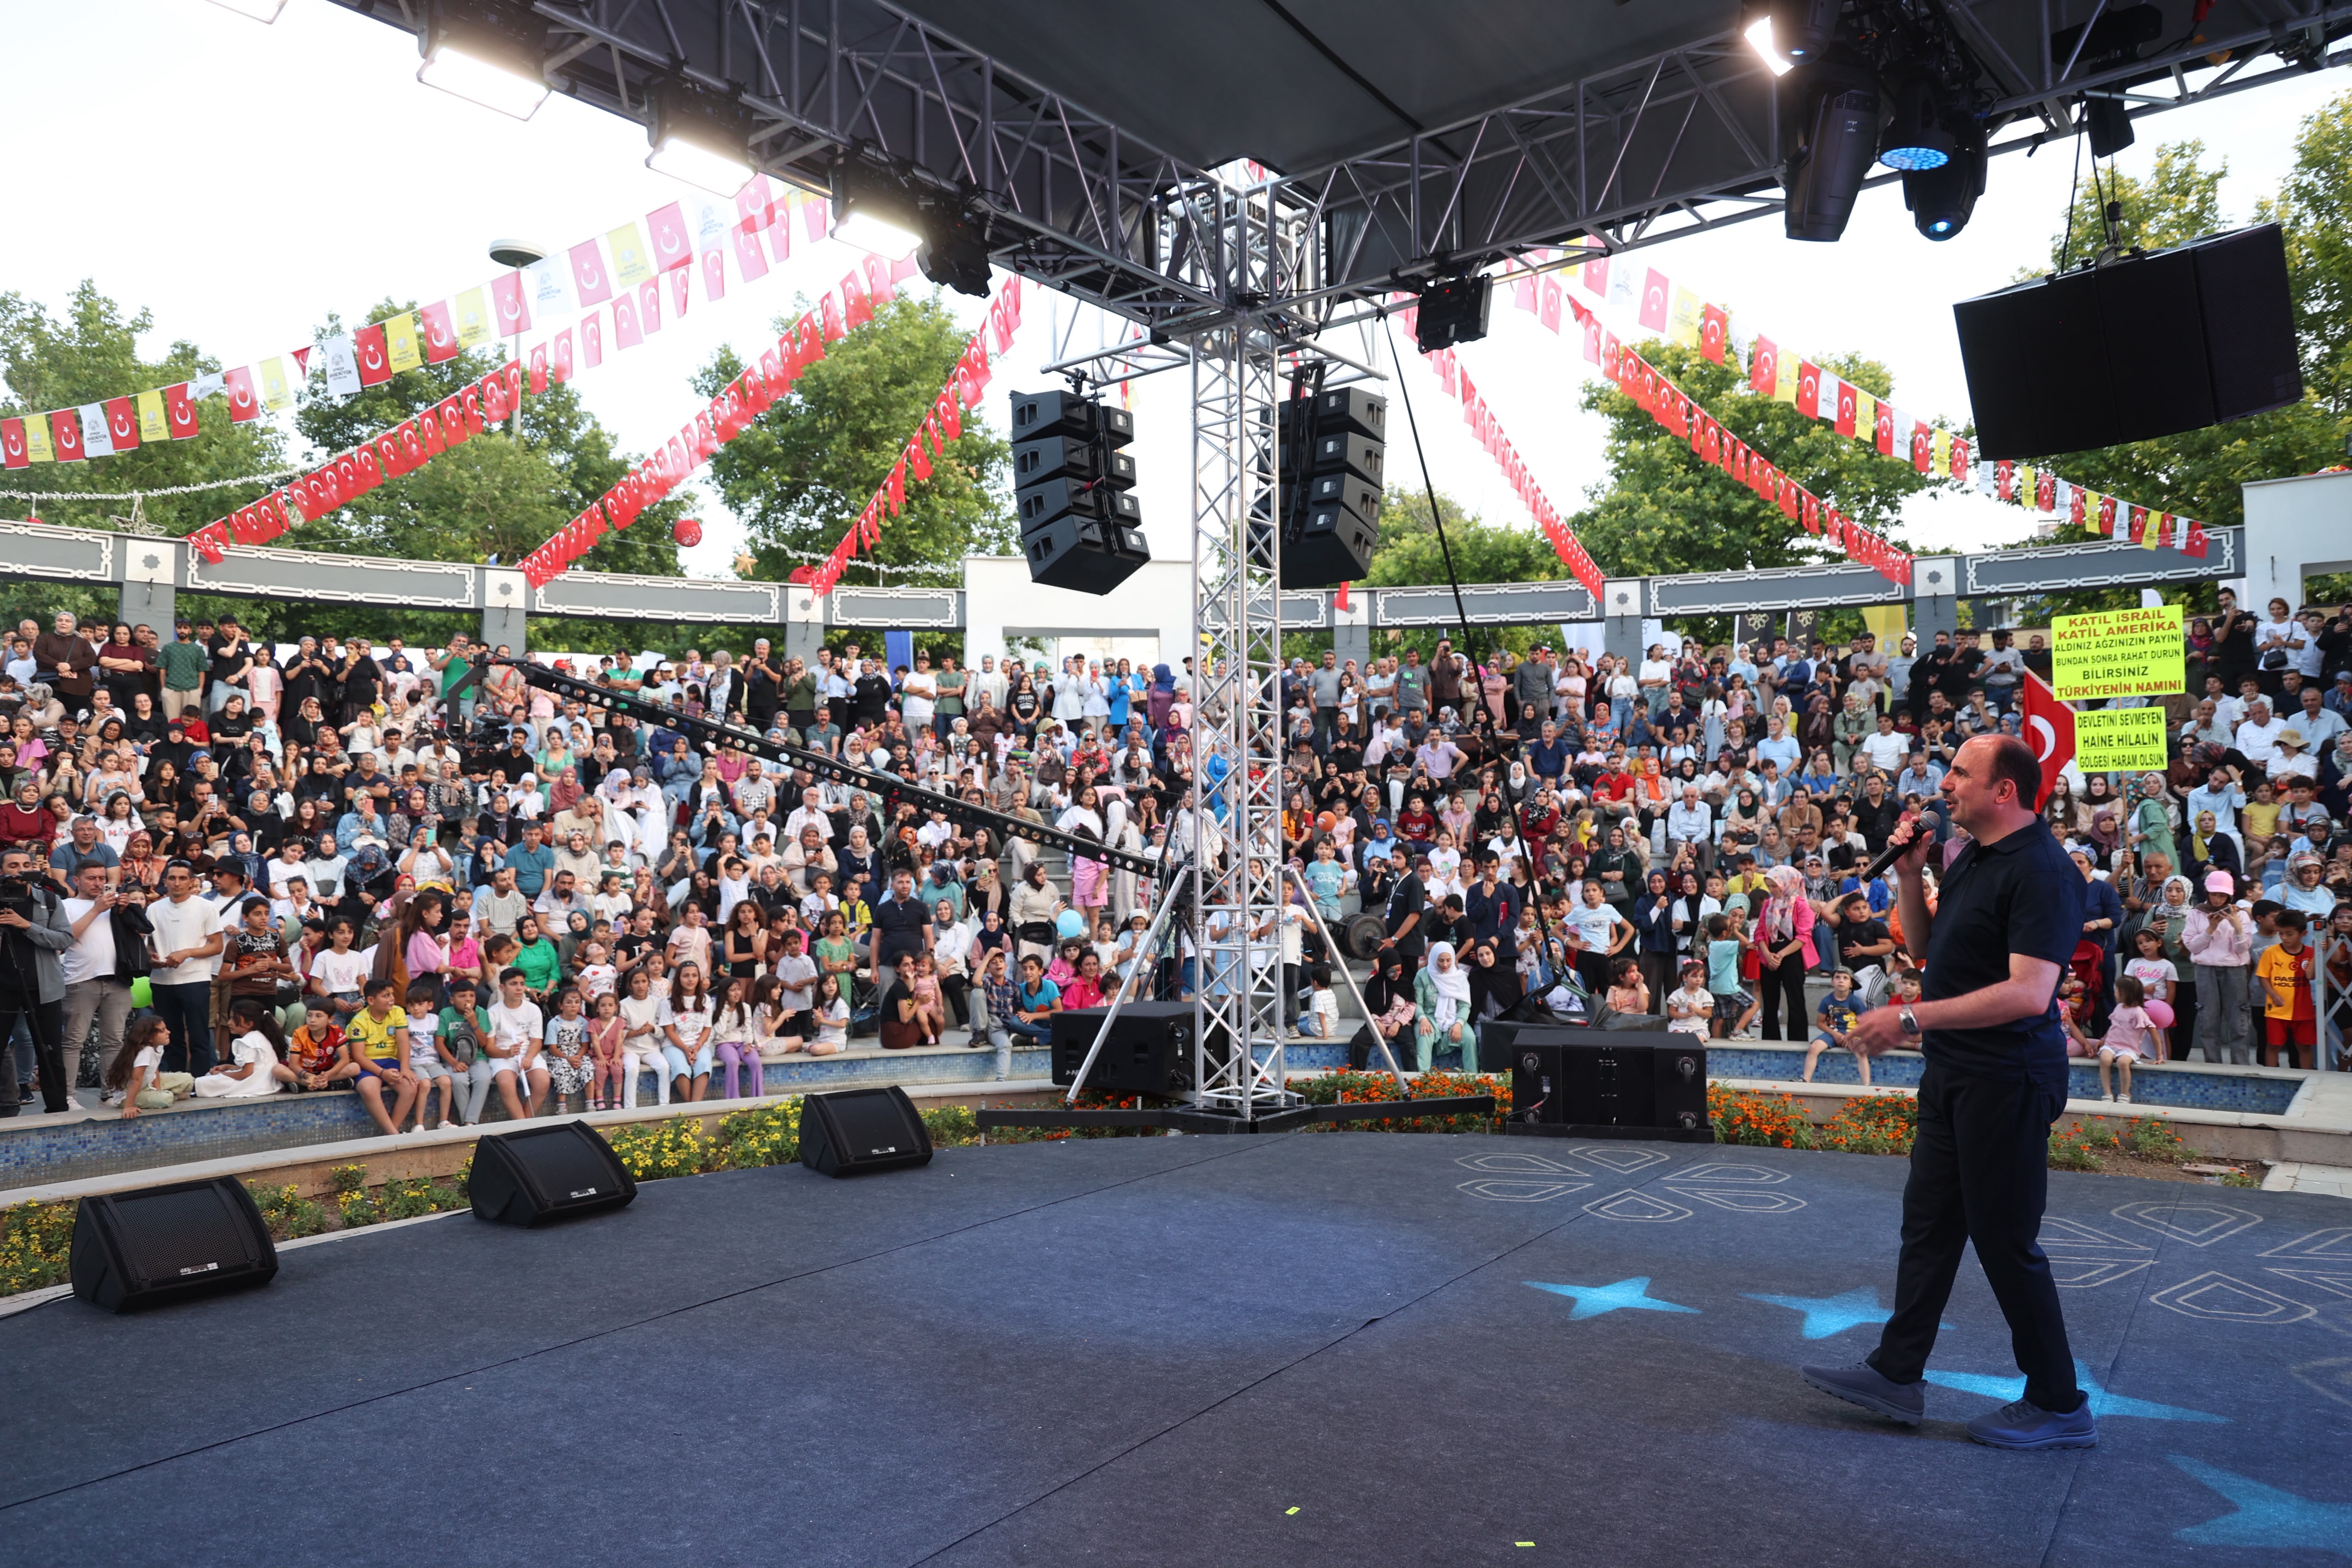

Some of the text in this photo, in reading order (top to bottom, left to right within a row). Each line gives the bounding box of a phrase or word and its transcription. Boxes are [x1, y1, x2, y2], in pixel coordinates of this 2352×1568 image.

[2058, 620, 2177, 640] KATİL AMERİKA
[2054, 633, 2181, 652] ALDINIZ AĞZINIZIN PAYINI
[2056, 649, 2180, 666] BUNDAN SONRA RAHAT DURUN
[2083, 666, 2148, 680] BİLİRSİNİZ
[2058, 680, 2182, 697] TÜRKİYENİN NAMINI
[2078, 711, 2162, 728] DEVLETİNİ SEVMEYEN
[2083, 730, 2159, 748] HAİNE HİLALİN
[2080, 752, 2164, 768] GÖLGESİ HARAM OLSUN
[2136, 966, 2163, 979] Barbie
